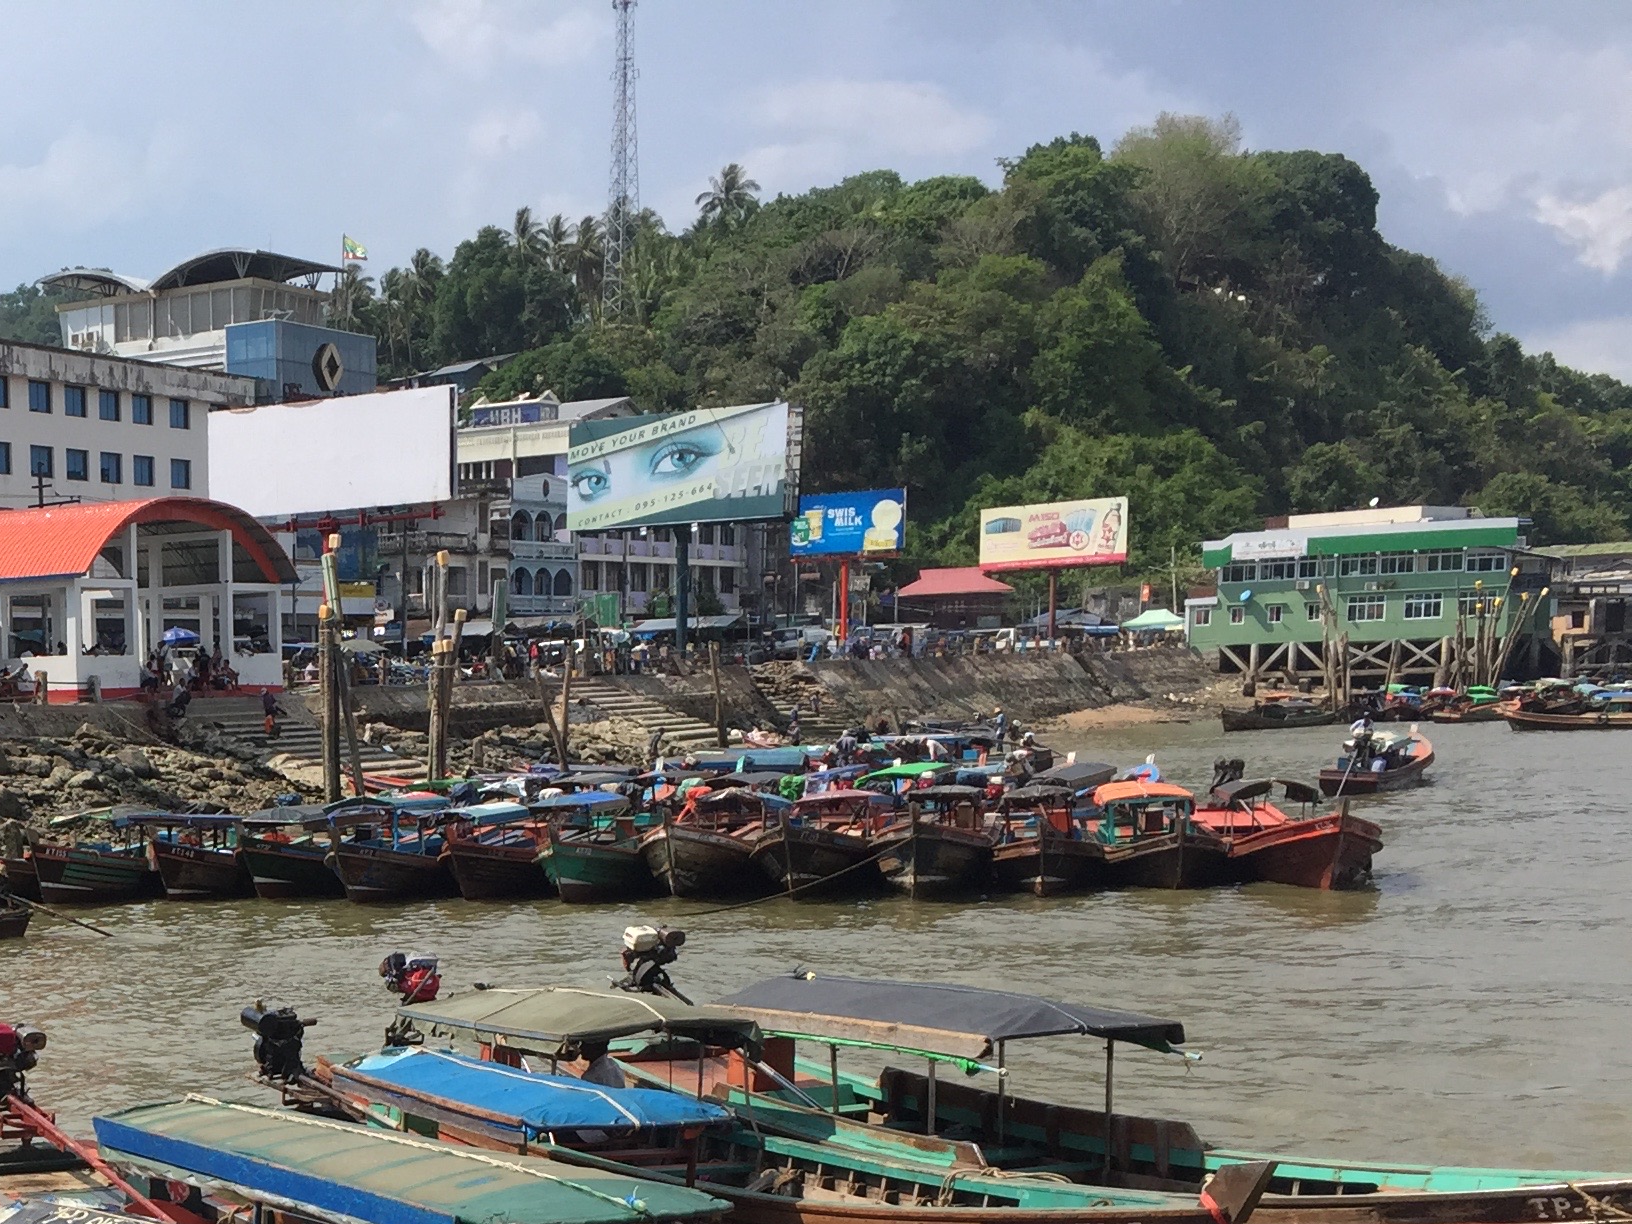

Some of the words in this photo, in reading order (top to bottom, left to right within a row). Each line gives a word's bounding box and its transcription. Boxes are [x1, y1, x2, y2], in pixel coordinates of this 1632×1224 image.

[570, 442, 605, 460] MOVE
[611, 429, 646, 448] YOUR
[652, 415, 696, 435] BRAND
[713, 463, 782, 499] SEEN
[579, 509, 623, 527] CONTACT
[828, 507, 856, 519] SWIS
[835, 515, 864, 527] MILK
